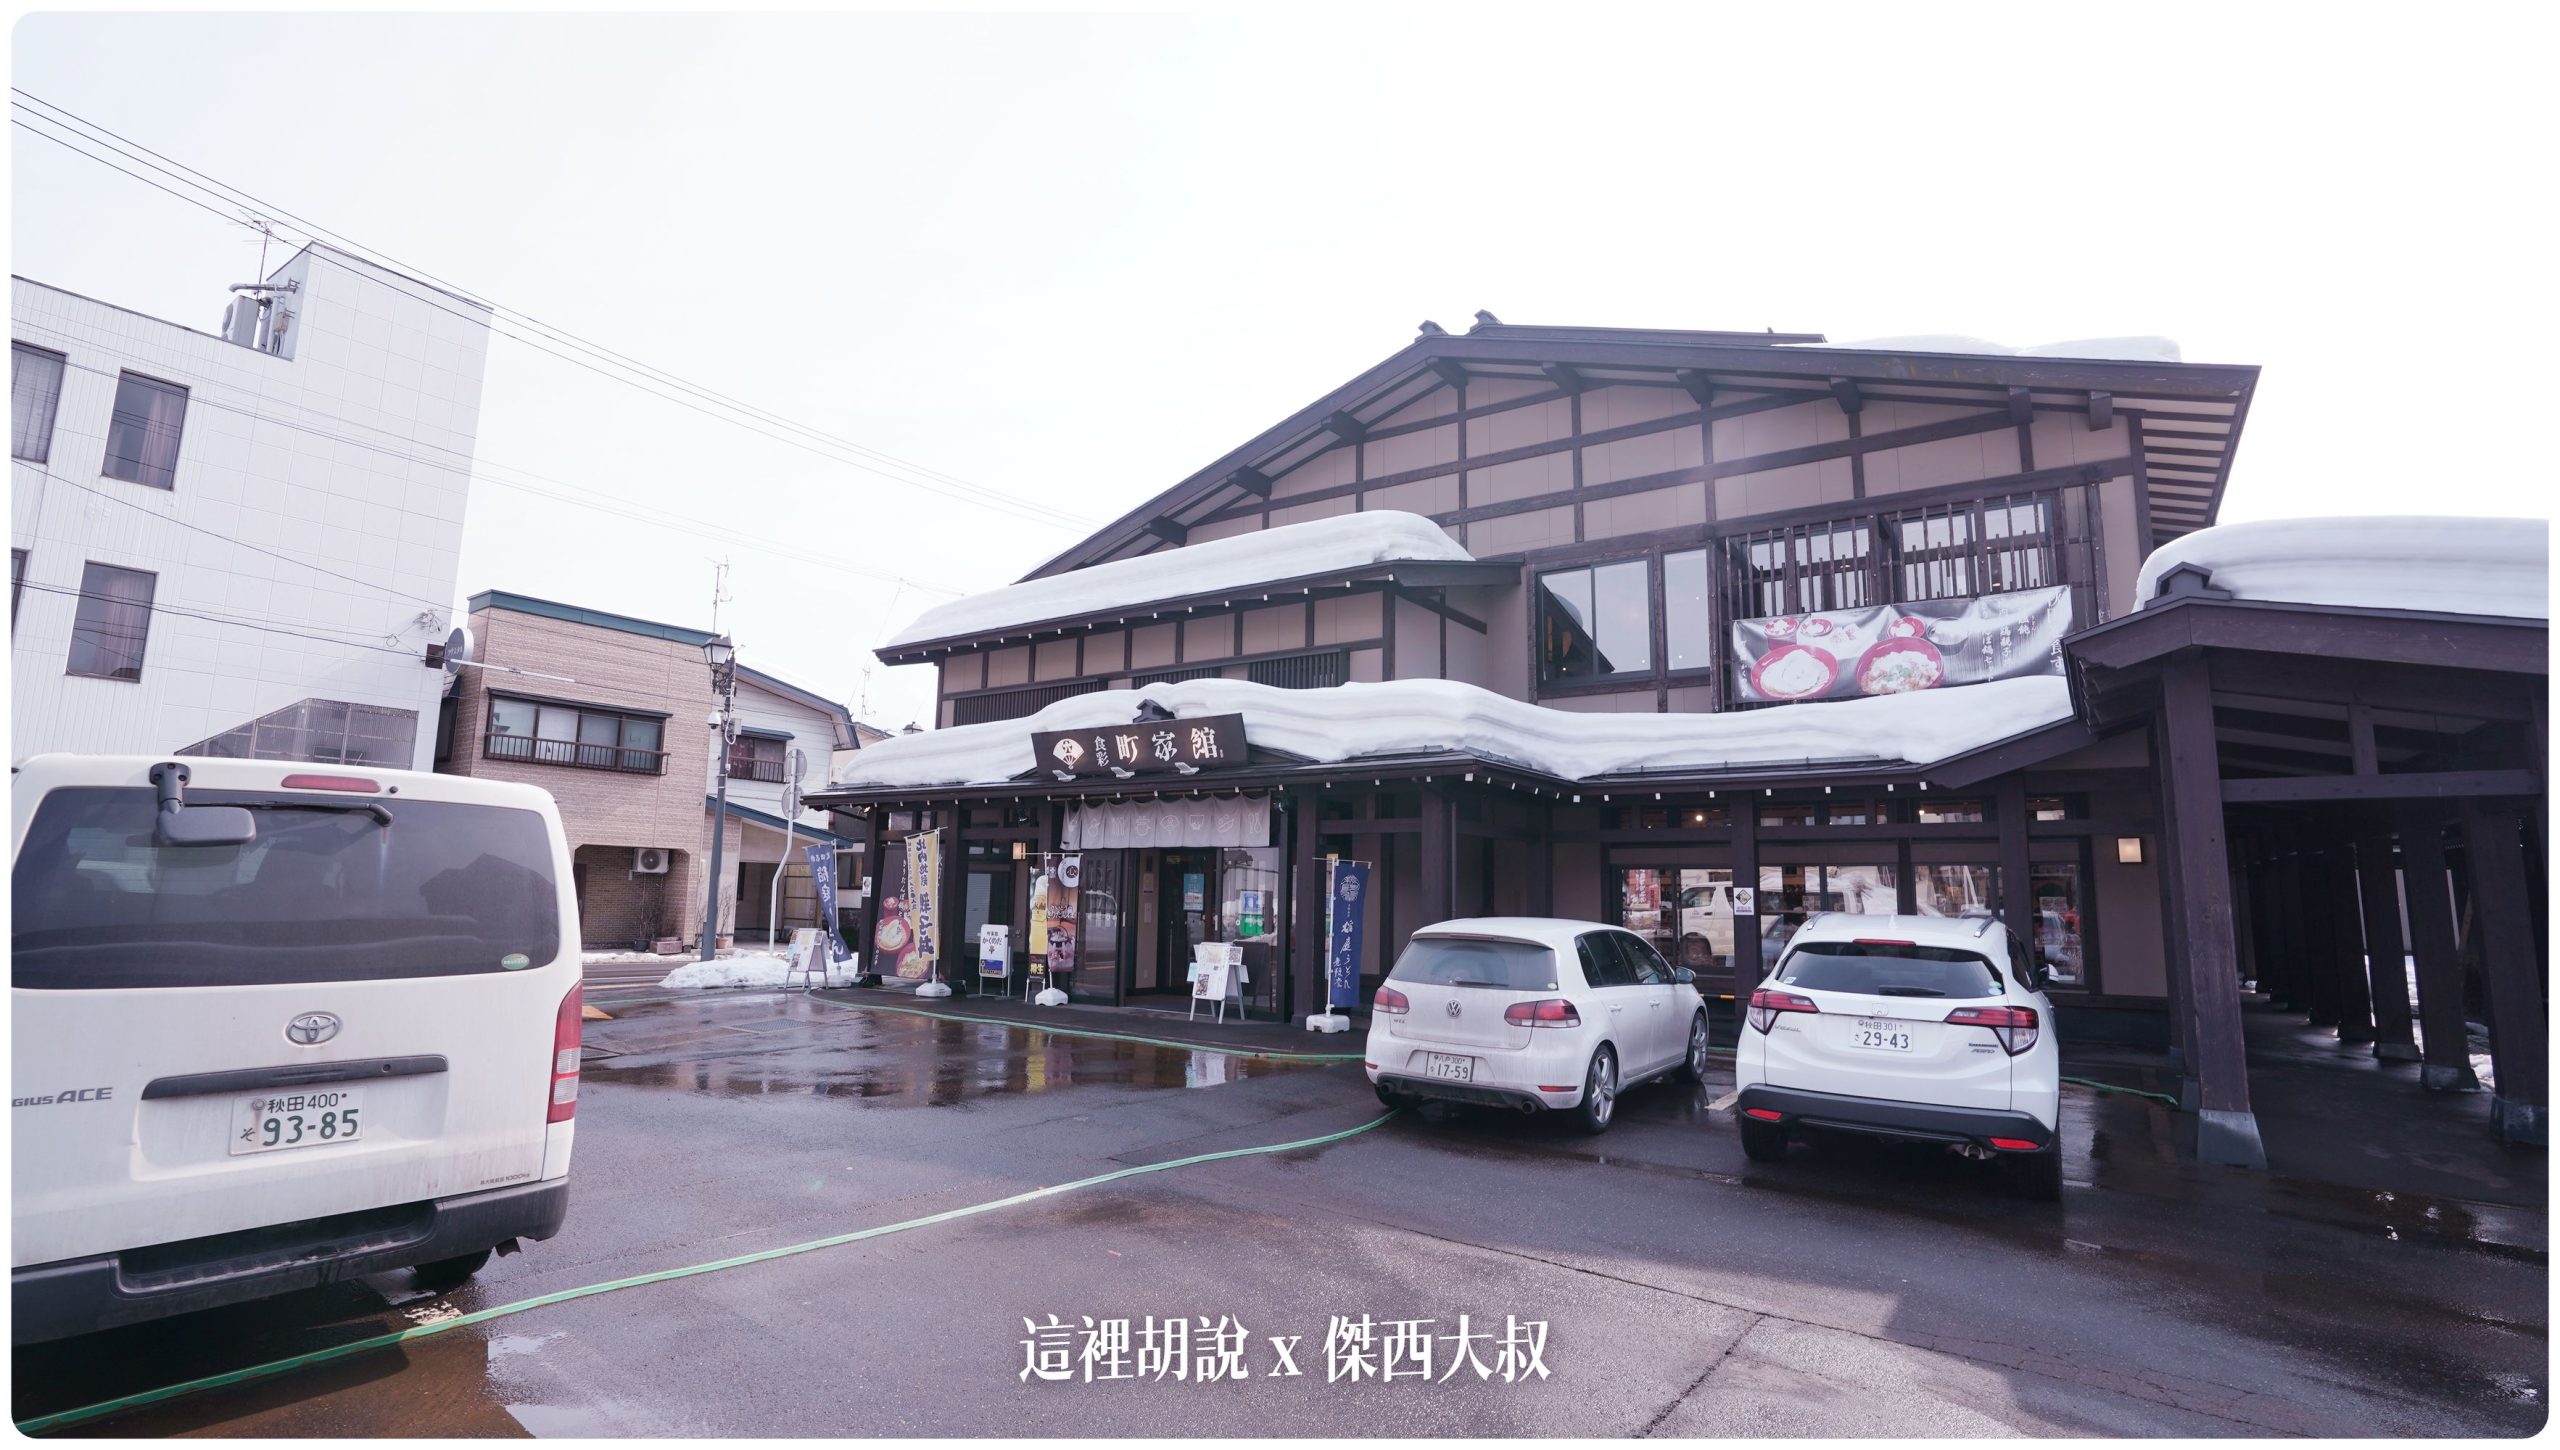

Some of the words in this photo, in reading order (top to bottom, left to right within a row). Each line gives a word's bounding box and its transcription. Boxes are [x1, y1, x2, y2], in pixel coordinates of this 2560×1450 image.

[1094, 735, 1110, 768] 食彩
[1114, 726, 1218, 765] 町家館
[1883, 1022, 1897, 1031] 301
[1863, 1031, 1909, 1049] 29-43
[1451, 1056, 1463, 1065] 300
[1437, 1063, 1469, 1080] 17-59
[56, 1087, 113, 1104] ACE
[267, 1096, 305, 1114] 秋田
[307, 1092, 339, 1109] 400
[240, 1127, 256, 1142] そ
[262, 1108, 359, 1147] 93-85
